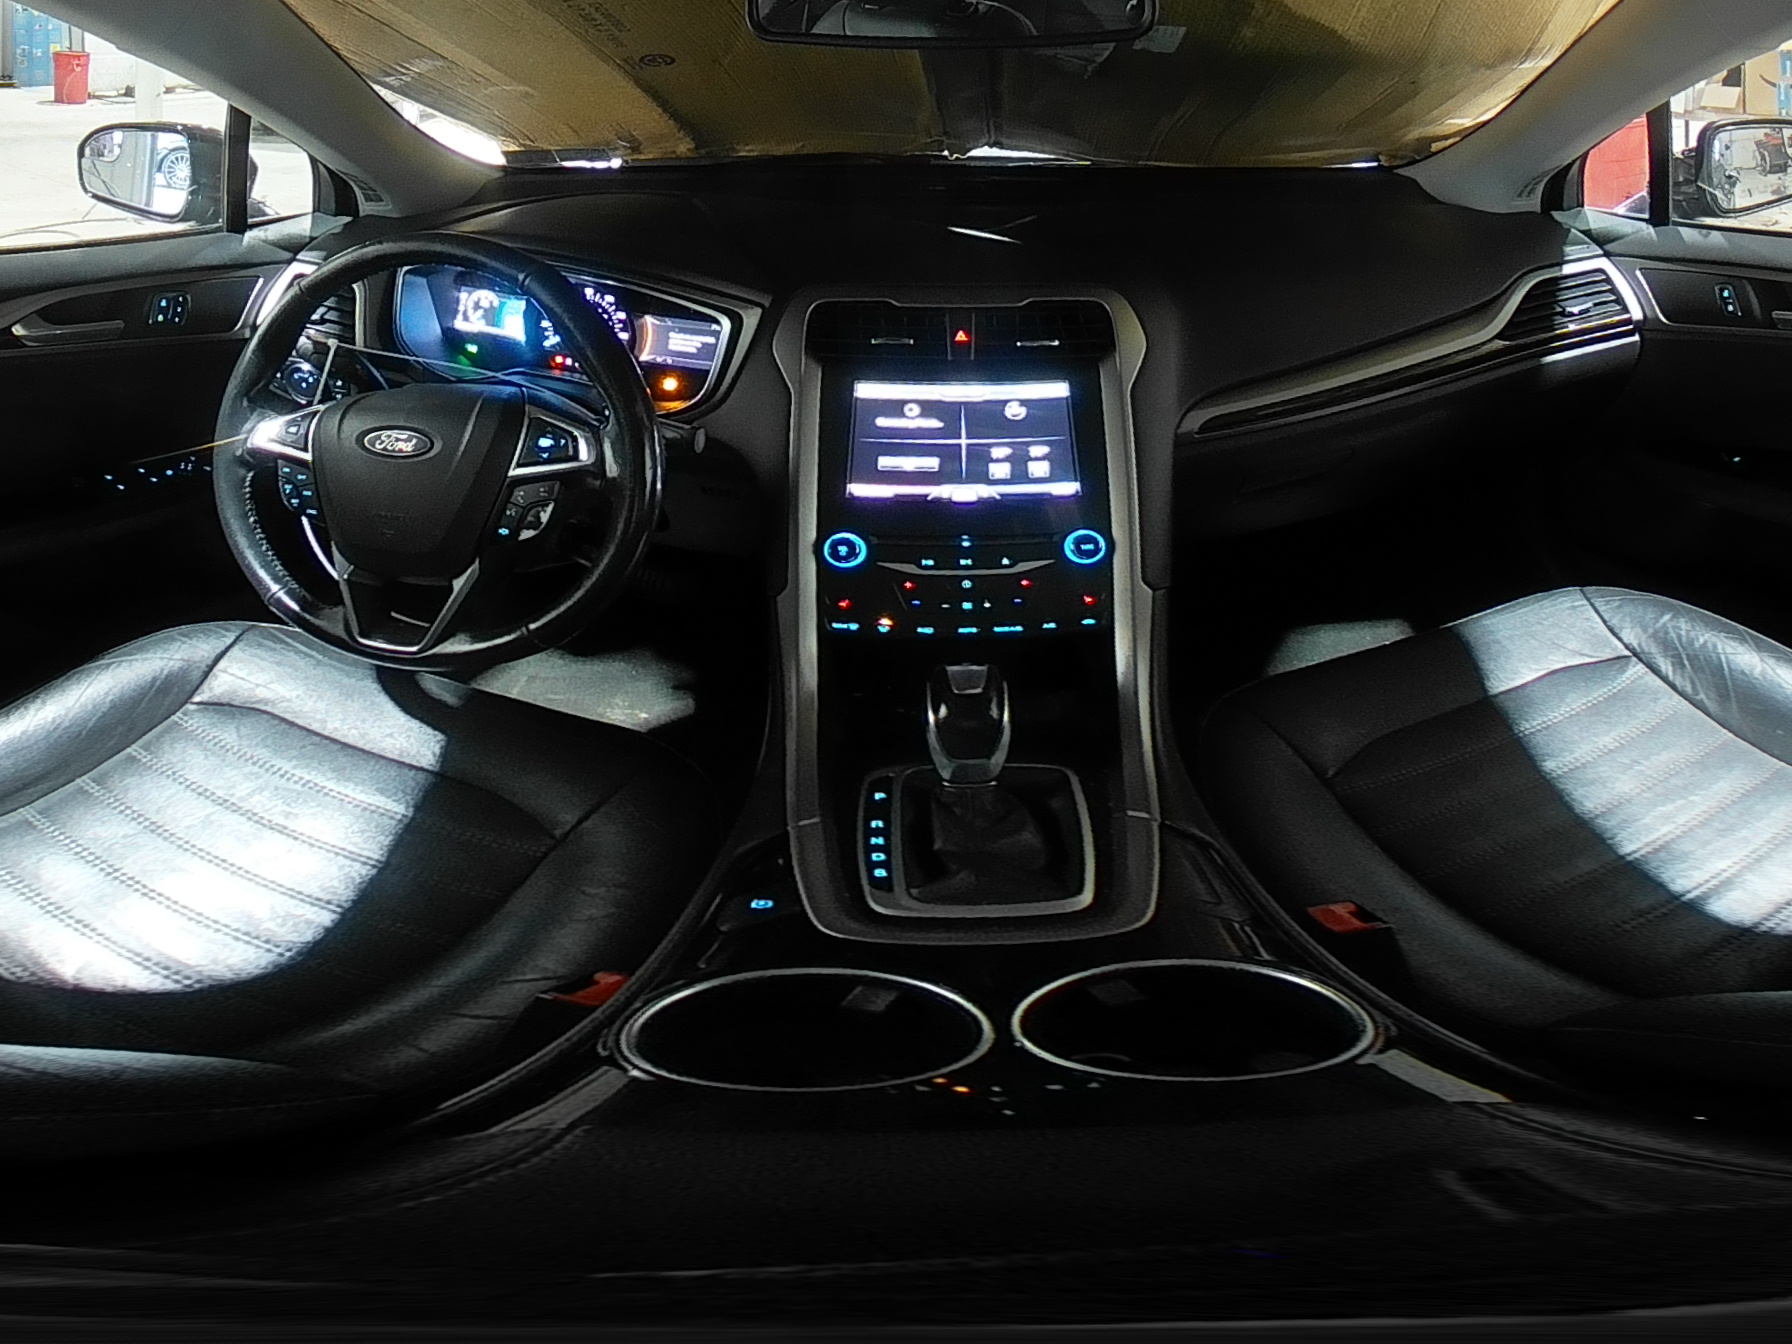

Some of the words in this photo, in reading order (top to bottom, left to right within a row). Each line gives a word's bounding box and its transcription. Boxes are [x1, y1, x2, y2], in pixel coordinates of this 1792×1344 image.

[375, 431, 418, 452] Ford
[870, 836, 885, 845] N
[871, 852, 887, 861] D
